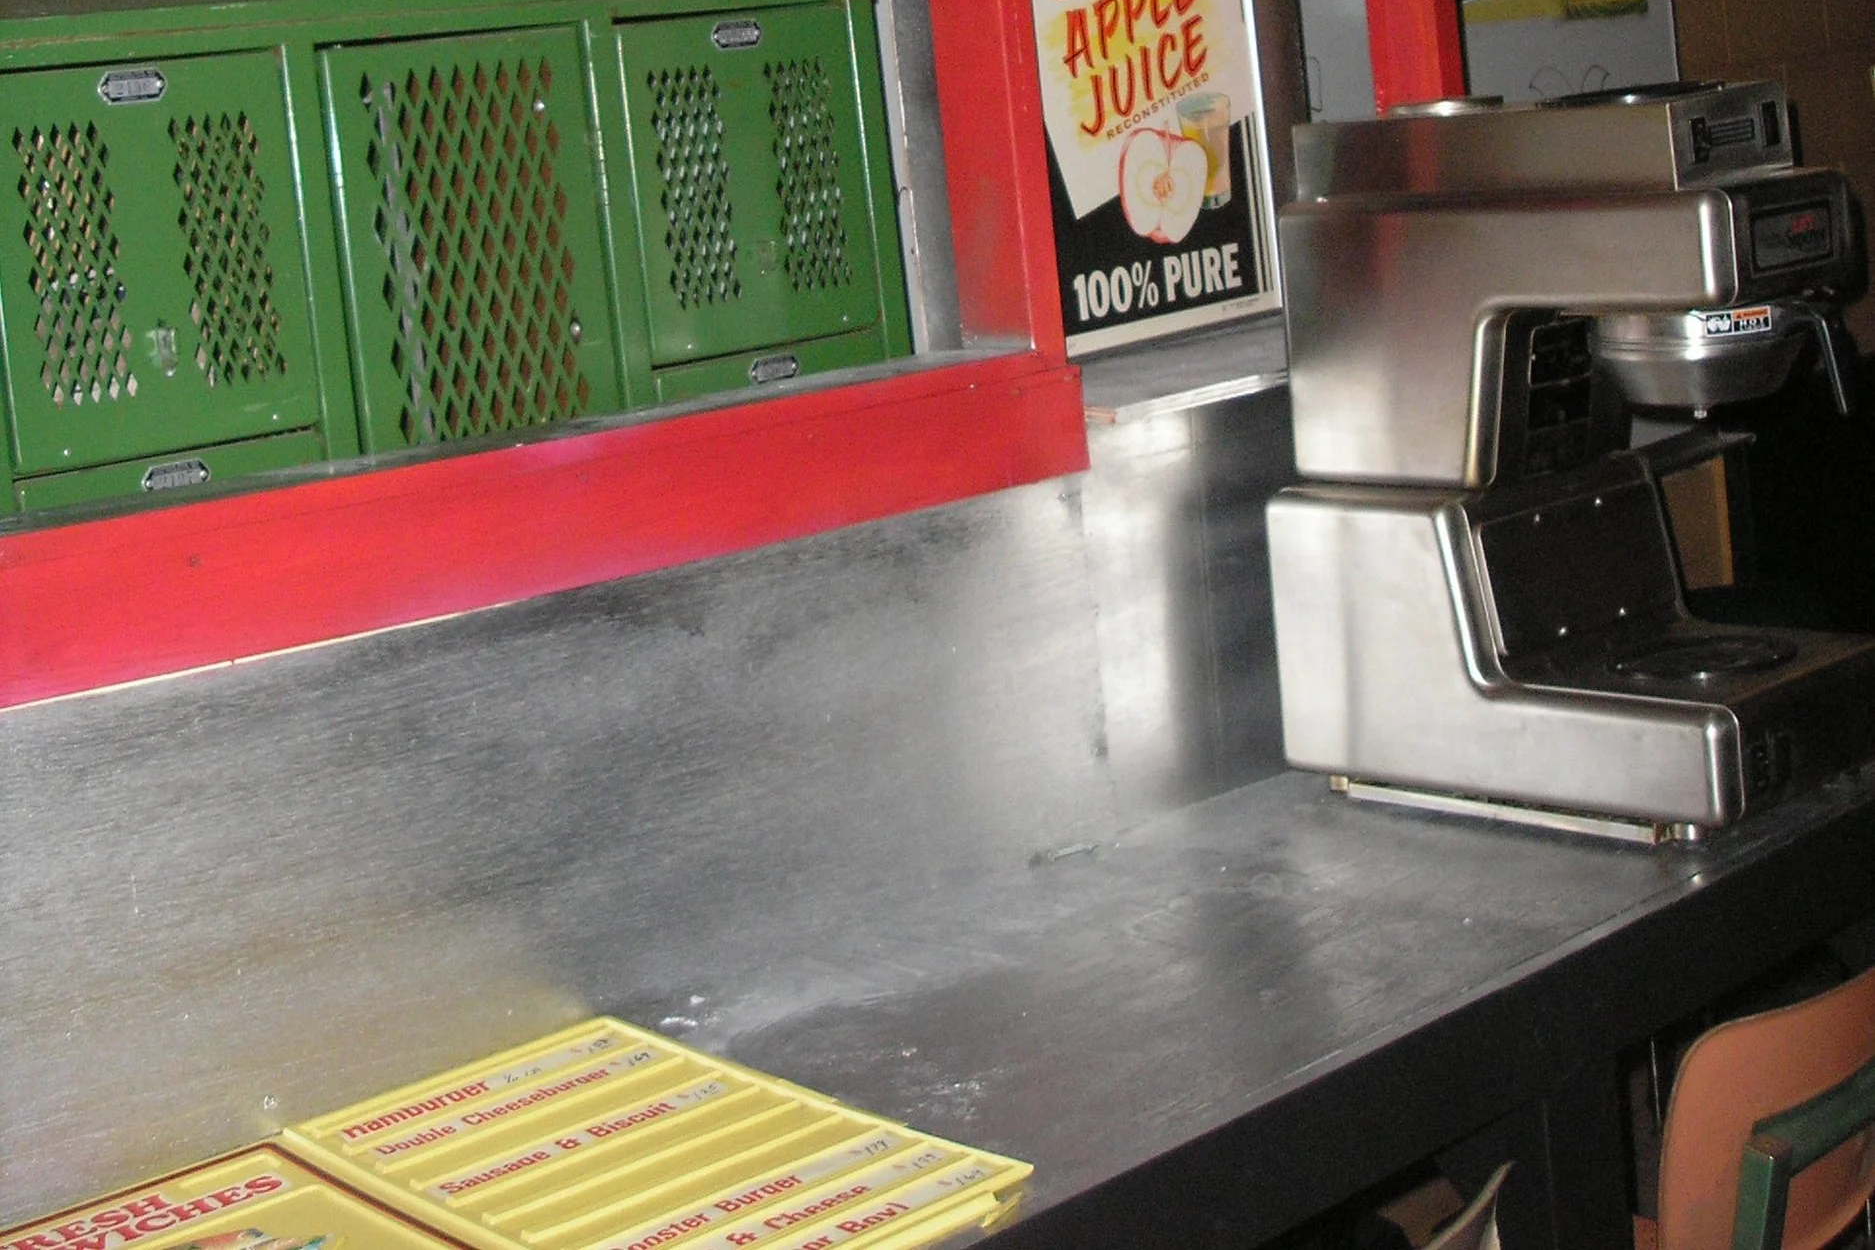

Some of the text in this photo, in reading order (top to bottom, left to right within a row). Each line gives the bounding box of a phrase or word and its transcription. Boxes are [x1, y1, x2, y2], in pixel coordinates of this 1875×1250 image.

[1080, 13, 1209, 139] JUICE
[1106, 71, 1210, 140] RECONSTITUTED
[1073, 241, 1243, 322] 100% PURE
[376, 1123, 457, 1155] Double
[461, 1067, 611, 1126] Cheeseburger
[439, 1150, 552, 1194] Sausage
[555, 1136, 582, 1150] &
[585, 1100, 677, 1139] Biscuit
[0, 1193, 172, 1250] RESH
[611, 1212, 711, 1250] ooster
[713, 1172, 804, 1213] Burger
[725, 1230, 757, 1247] &
[762, 1183, 873, 1231] Cheese
